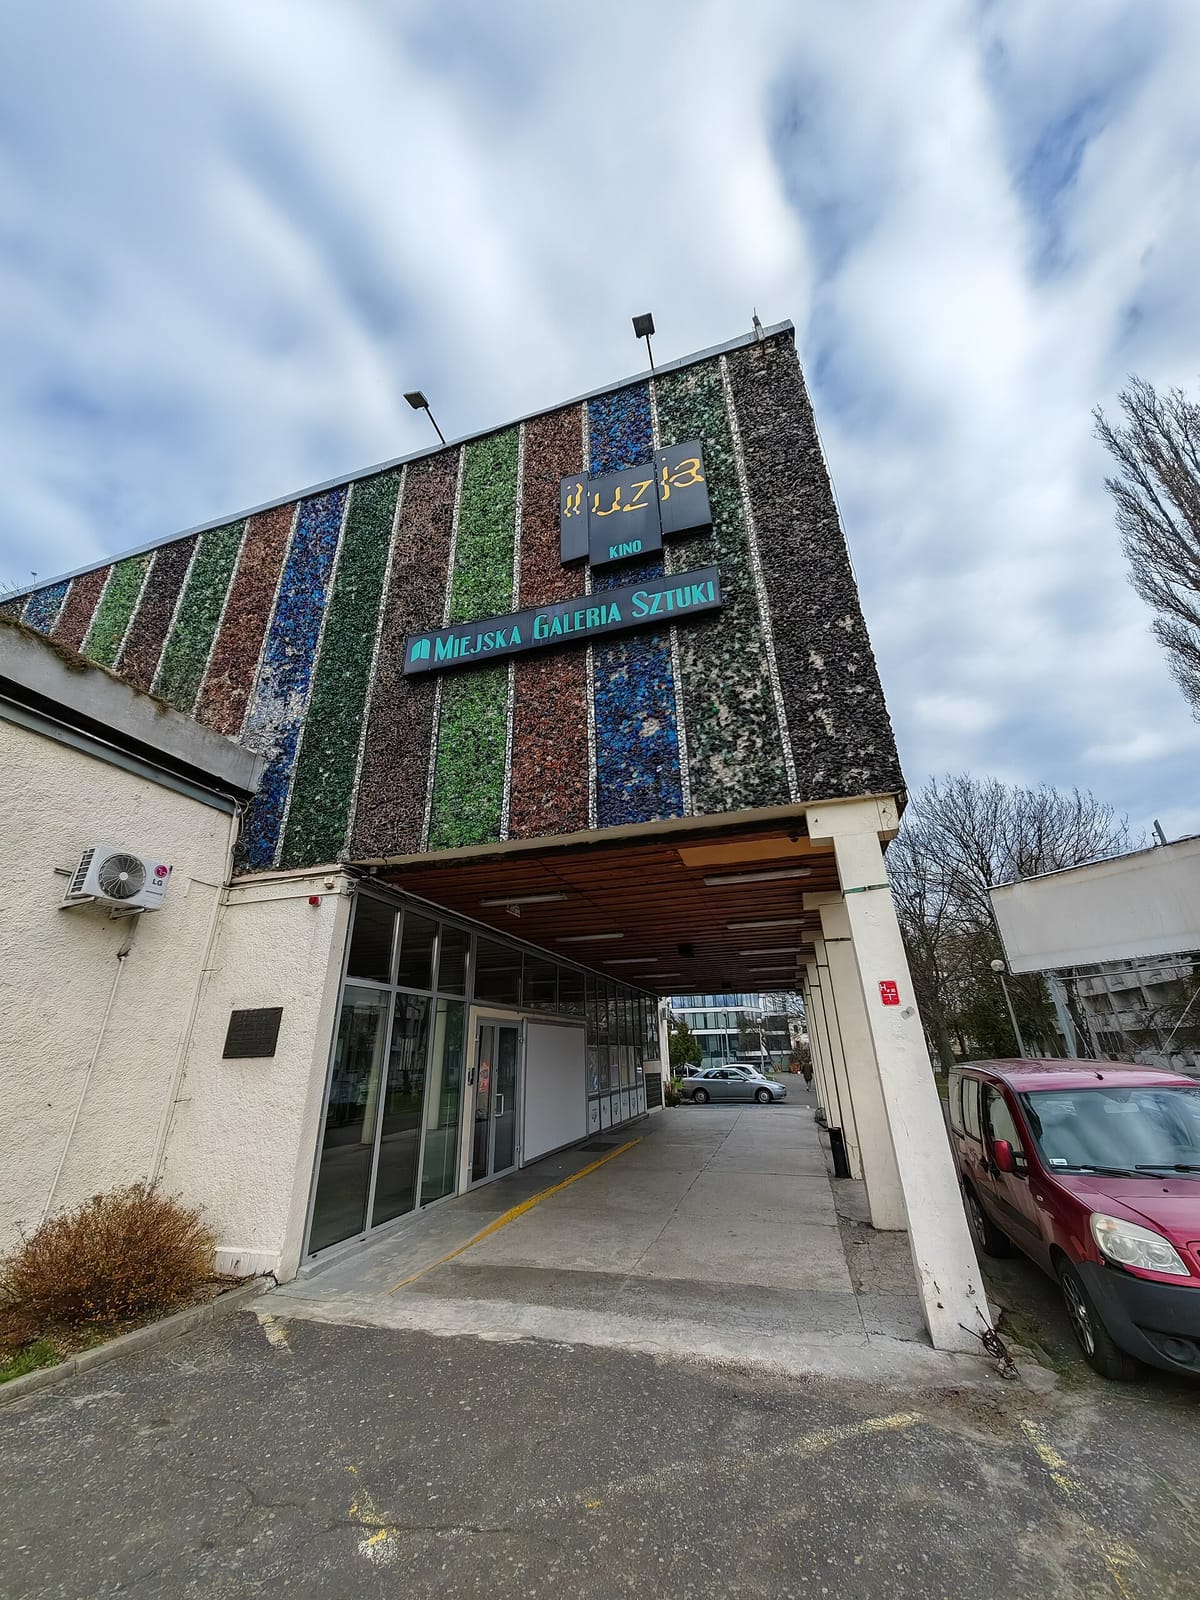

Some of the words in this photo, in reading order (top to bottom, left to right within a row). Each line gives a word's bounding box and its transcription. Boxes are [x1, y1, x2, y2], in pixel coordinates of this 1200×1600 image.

[609, 540, 642, 559] KINO
[434, 625, 522, 662] MIEJSKA
[533, 602, 622, 640] GALERIA
[631, 580, 715, 618] SZTUKI
[152, 878, 163, 887] LG
